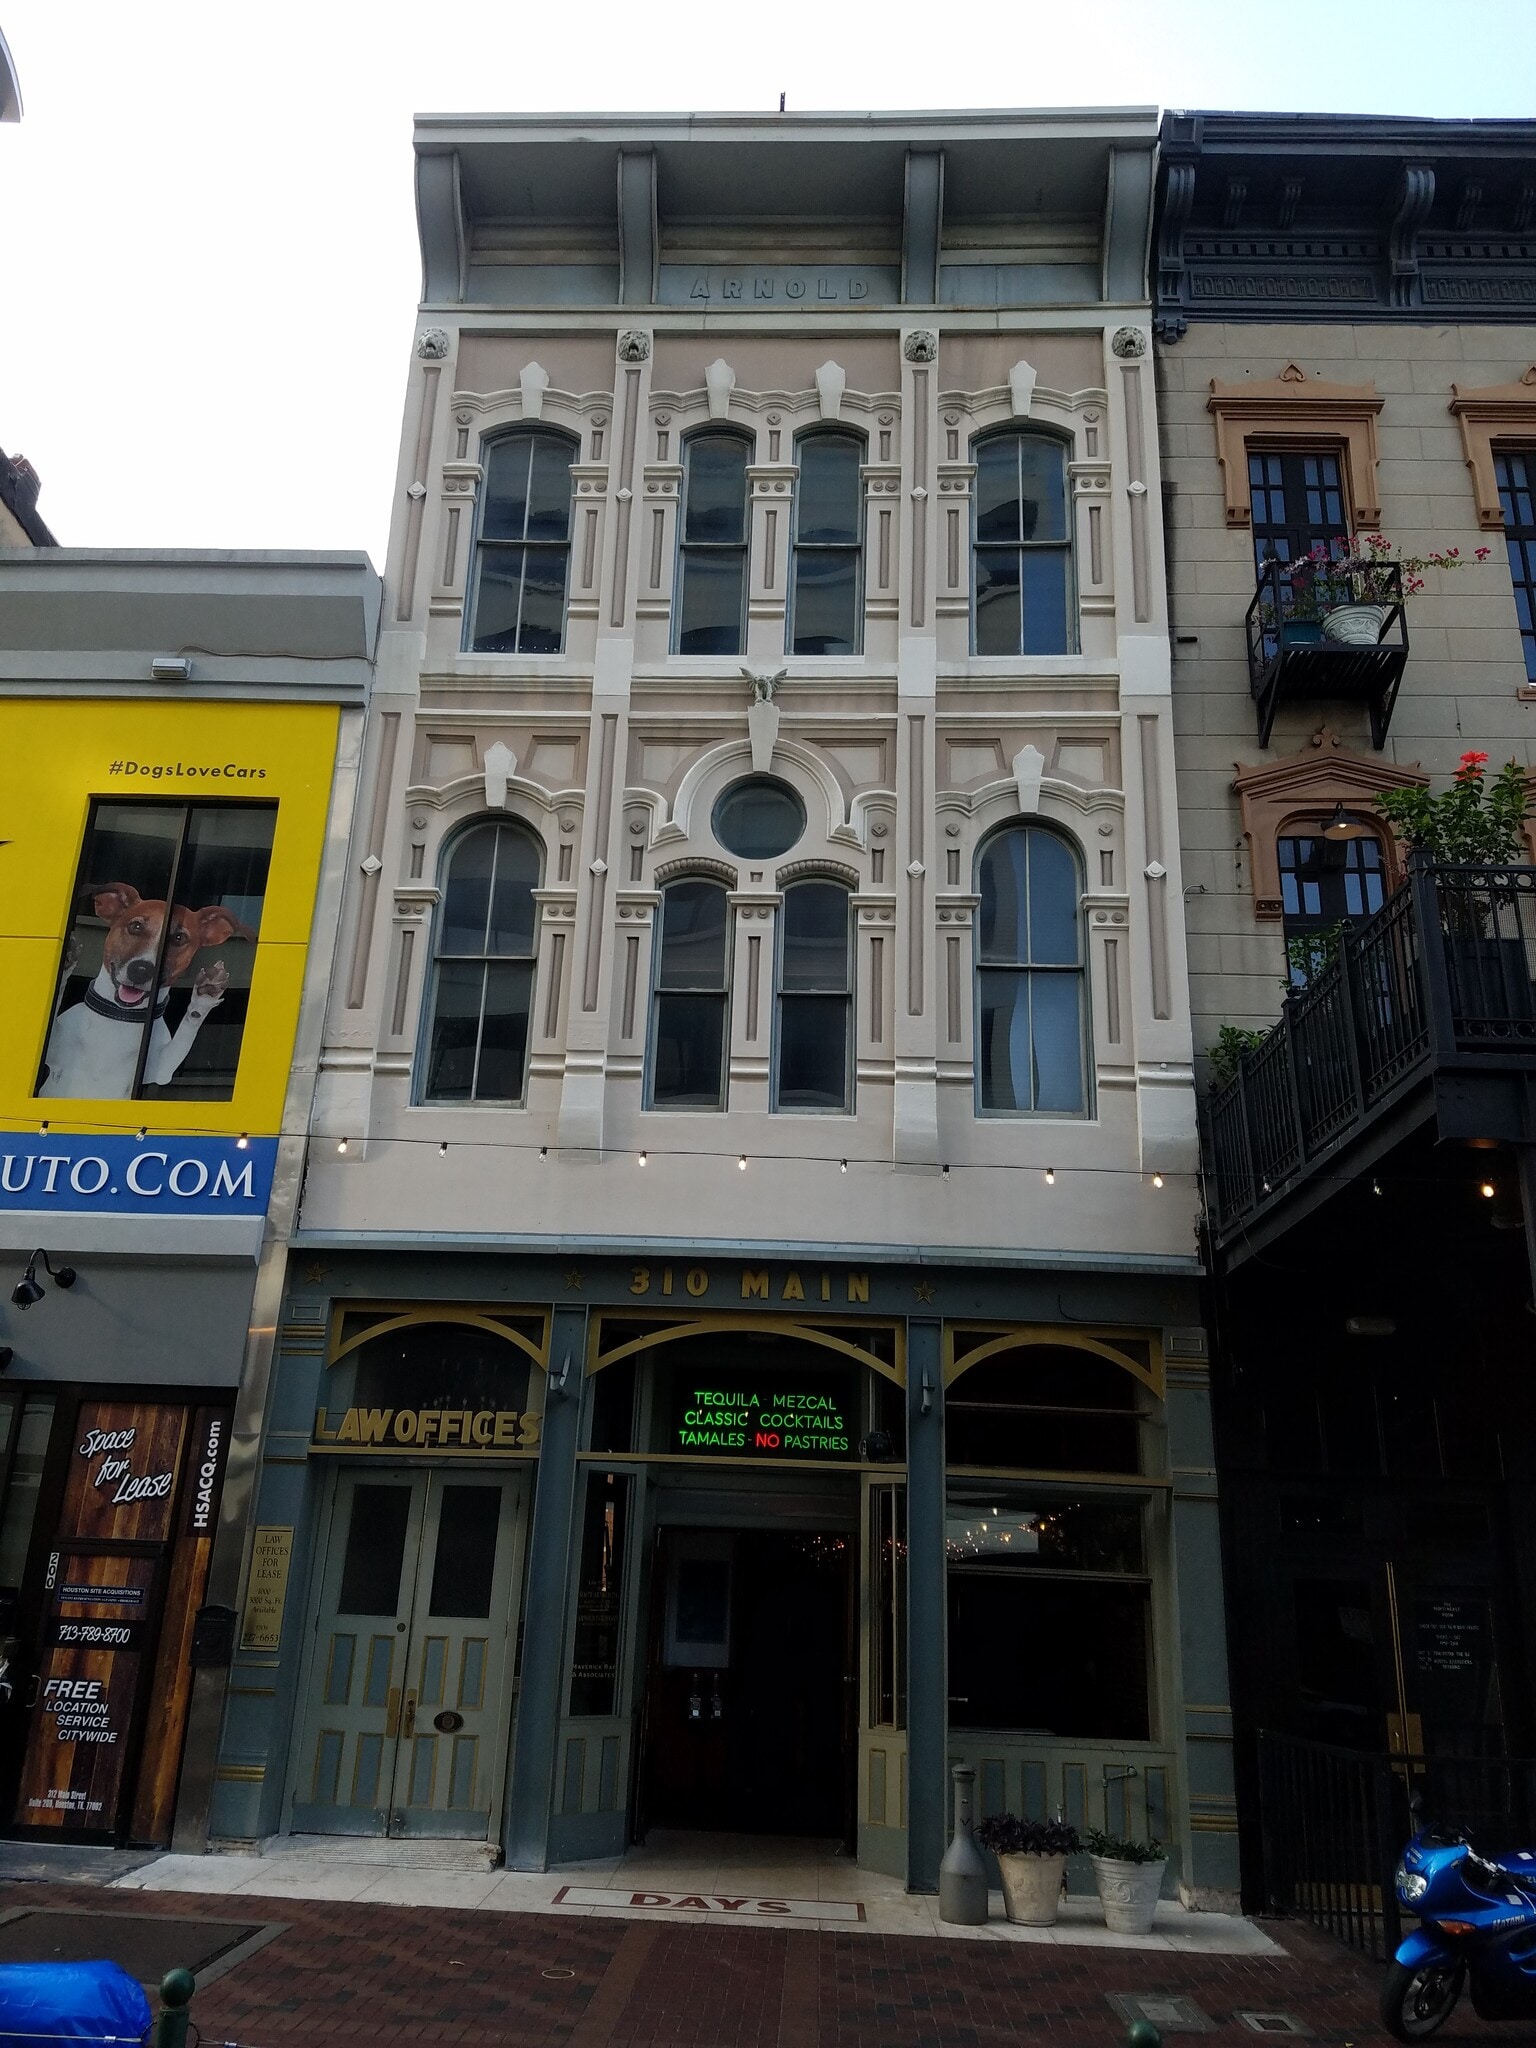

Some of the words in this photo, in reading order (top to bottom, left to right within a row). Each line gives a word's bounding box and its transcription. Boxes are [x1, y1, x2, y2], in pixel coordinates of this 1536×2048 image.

[690, 278, 869, 300] ARNOLD
[109, 760, 267, 779] #DogsLoveCars
[628, 1266, 710, 1297] 310
[740, 1268, 870, 1303] MAIN
[694, 1391, 760, 1407] TEQUILA
[773, 1394, 837, 1410] MEZCAL
[315, 1407, 395, 1442] LAW
[394, 1410, 543, 1446] OFFICES
[684, 1411, 749, 1426] CLASSIC
[760, 1413, 844, 1430] COCKTAILS
[80, 1428, 136, 1459] Space
[679, 1430, 745, 1447] TAMALES
[755, 1433, 780, 1448] NO
[784, 1435, 849, 1451] PASTRIES
[95, 1455, 130, 1487] for
[193, 1420, 222, 1528] HSACQ.com
[112, 1472, 173, 1503] Lease
[265, 1535, 283, 1544] LAW
[255, 1546, 289, 1556] OFFICES
[47, 1553, 58, 1588] 200
[262, 1557, 279, 1567] FOR
[257, 1569, 282, 1579] LEASE
[62, 1586, 90, 1594] HOUSTON
[90, 1587, 102, 1595] SITE
[102, 1588, 141, 1596] ACQUISITIONS
[58, 1624, 131, 1644] 713-789-8700
[43, 1679, 102, 1700] FREE
[46, 1701, 109, 1715] LOCATION
[56, 1715, 110, 1728] SERVICE
[57, 1729, 118, 1744] CITYWIDE
[629, 1892, 792, 1914] DAYS
